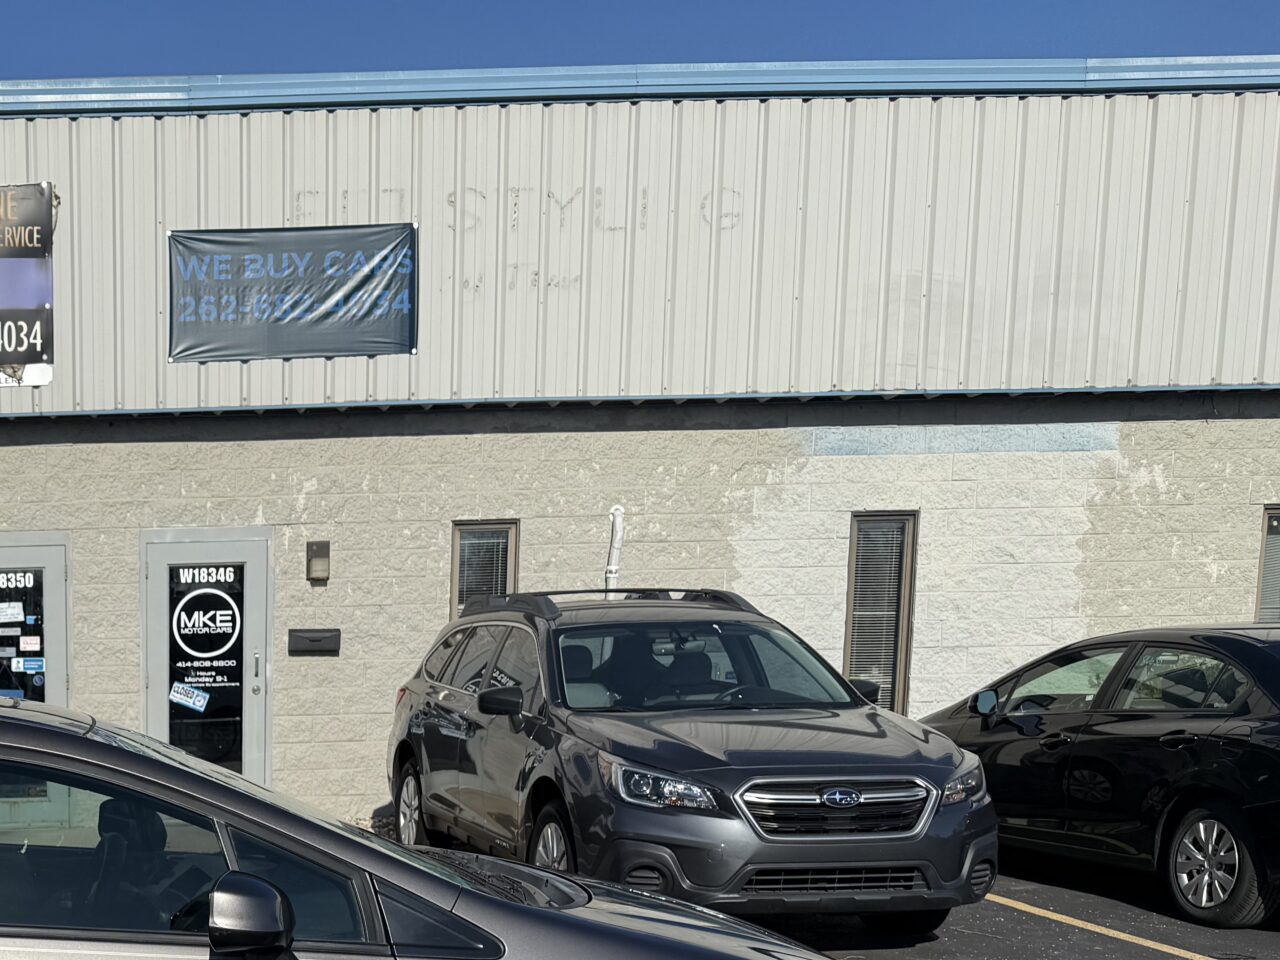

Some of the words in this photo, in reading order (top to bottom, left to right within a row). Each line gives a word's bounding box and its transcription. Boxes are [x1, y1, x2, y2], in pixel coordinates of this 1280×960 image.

[176, 254, 232, 281] WE
[244, 251, 312, 279] BUY
[179, 567, 234, 583] W18346
[180, 610, 233, 628] MKE
